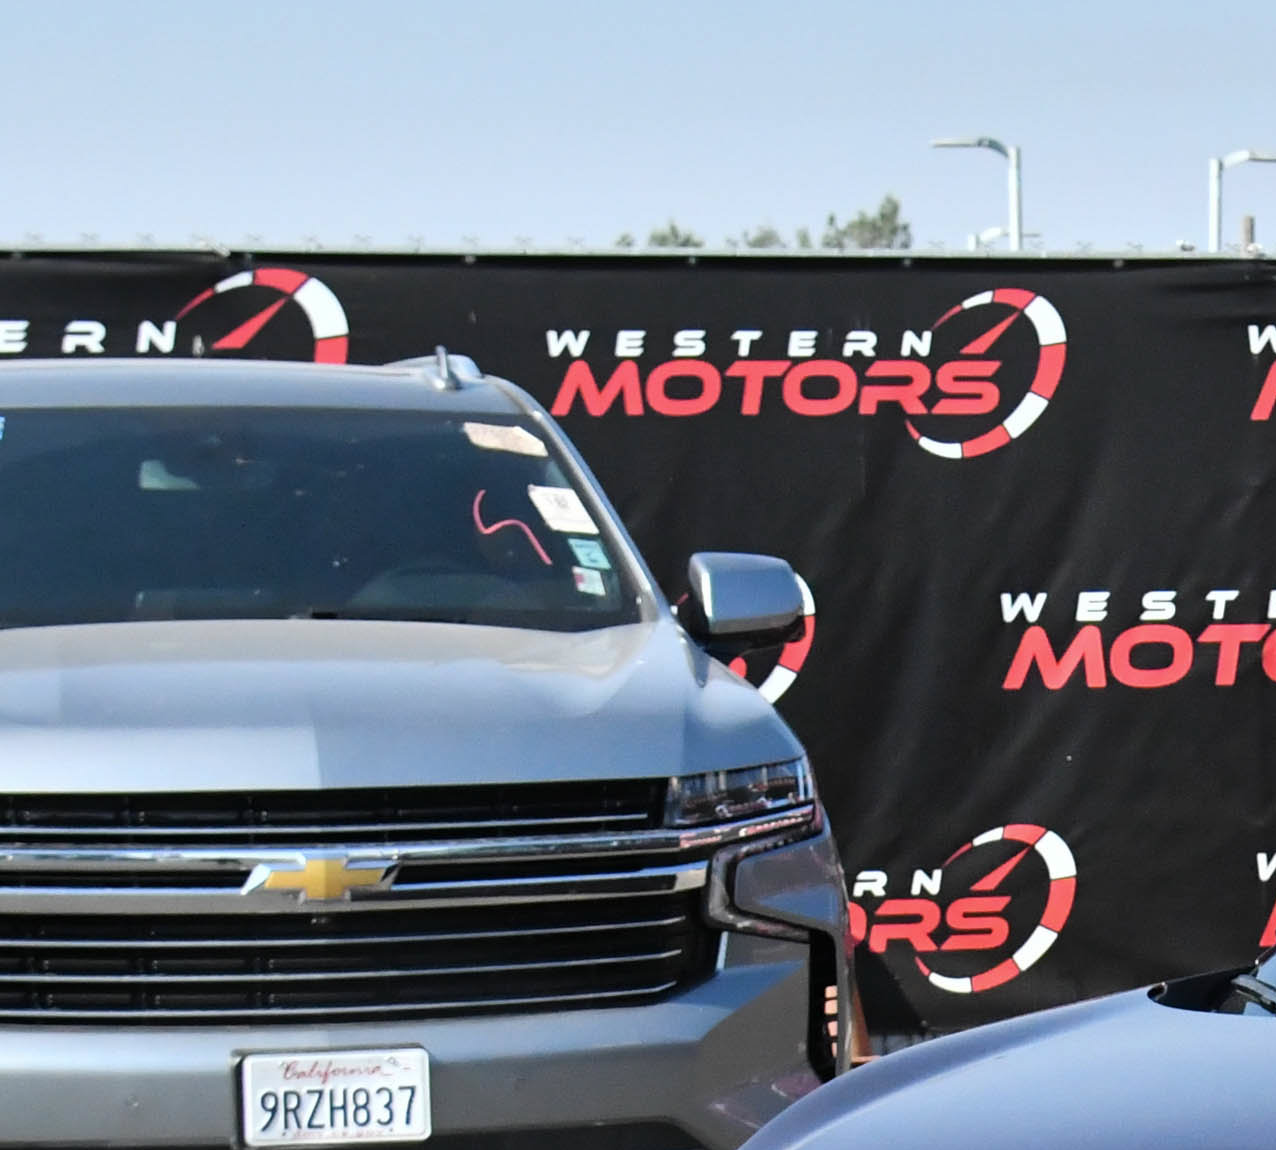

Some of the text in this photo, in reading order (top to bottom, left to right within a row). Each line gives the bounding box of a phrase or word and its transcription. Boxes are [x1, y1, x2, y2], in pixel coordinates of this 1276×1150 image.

[0, 320, 177, 353] ERN
[547, 330, 932, 357] WESTERN
[551, 359, 1001, 416] MOTORS
[281, 1059, 393, 1085] California
[261, 1085, 417, 1133] 9RZH837
